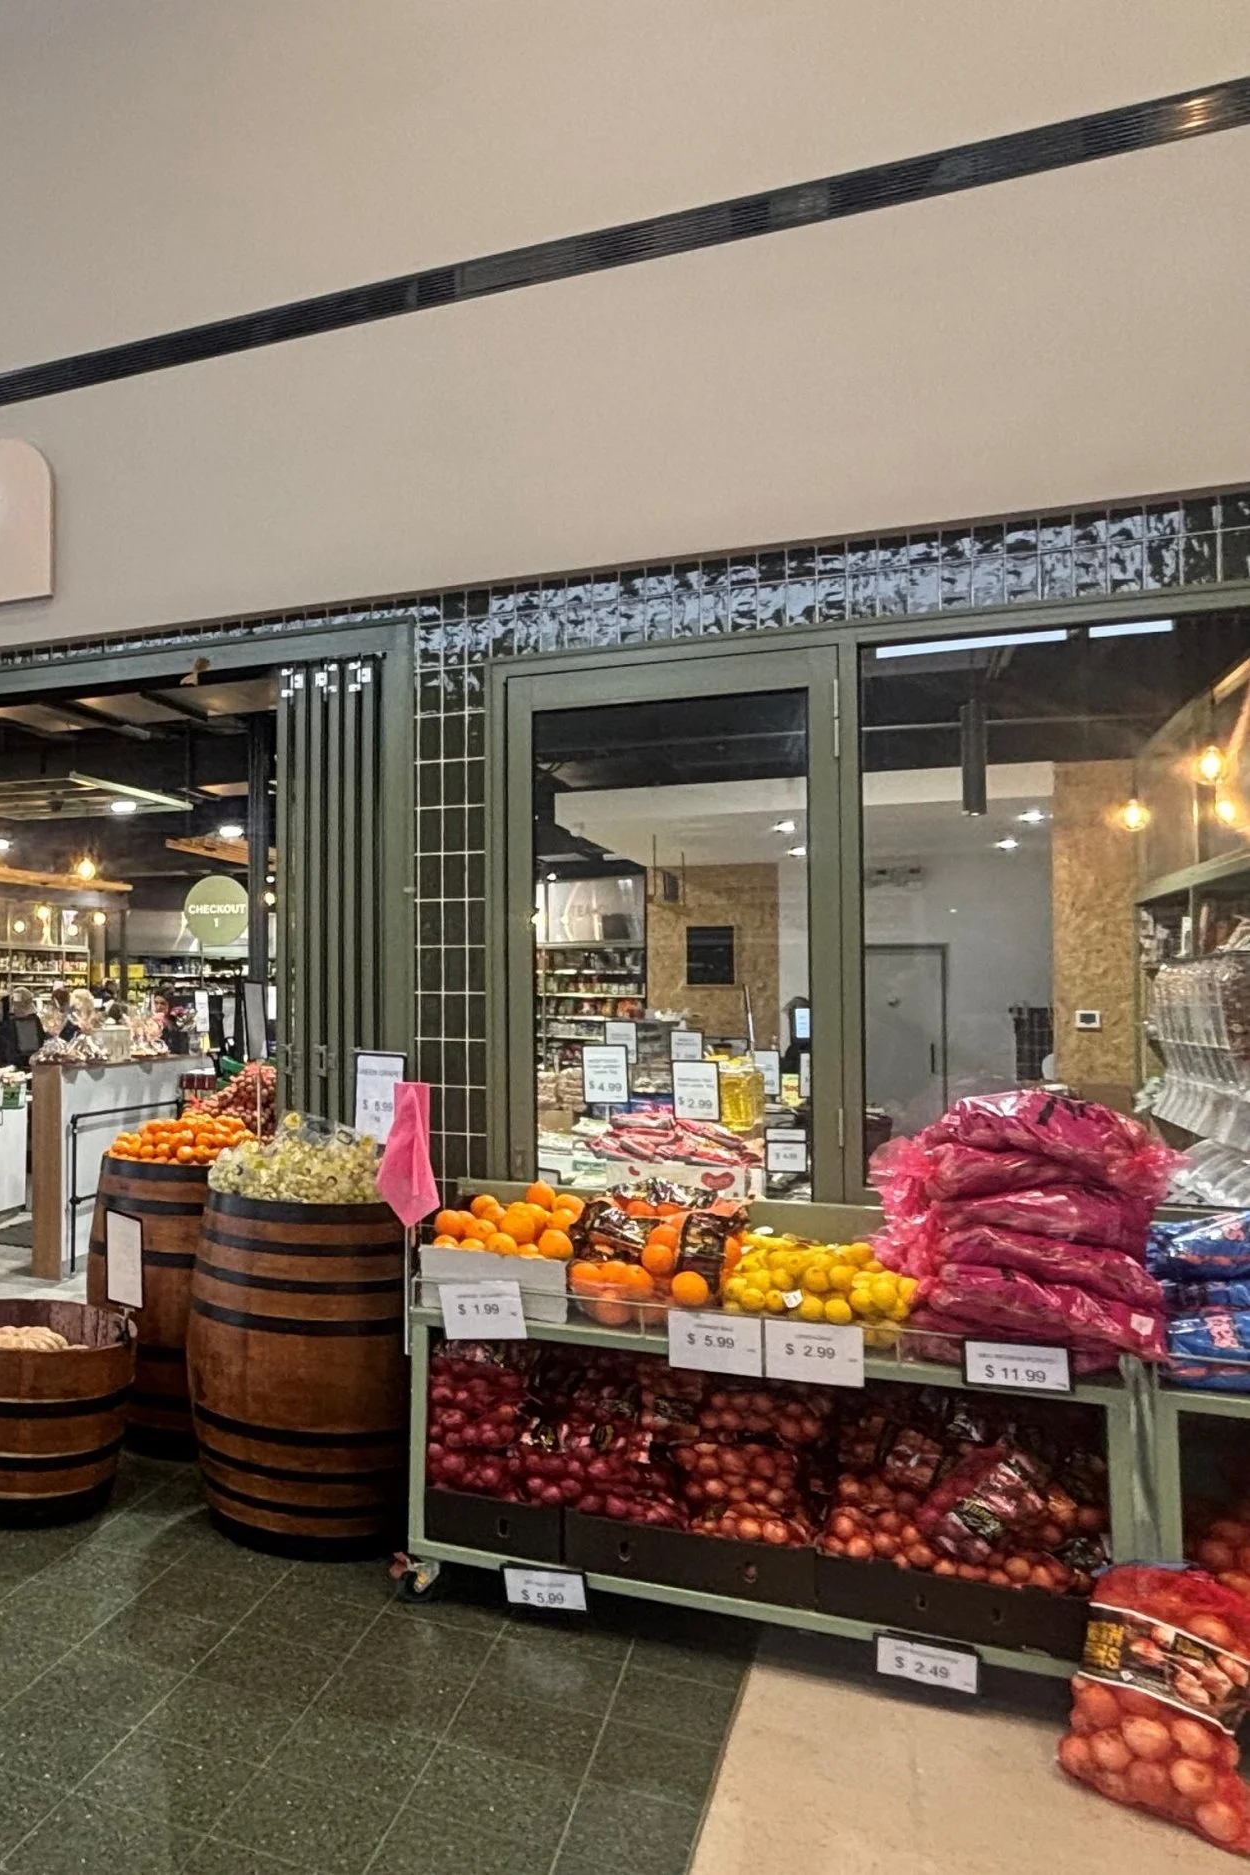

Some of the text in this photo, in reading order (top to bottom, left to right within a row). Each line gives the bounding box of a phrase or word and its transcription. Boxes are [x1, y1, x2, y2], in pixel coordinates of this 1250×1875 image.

[188, 903, 246, 914] CHECKOUT
[213, 917, 219, 928] 1
[589, 1080, 623, 1093] $ 4.99
[362, 1099, 368, 1110] $
[678, 1096, 713, 1110] $ 2.99
[457, 1303, 467, 1316] $
[474, 1303, 500, 1315] 1.99
[687, 1333, 735, 1349] $ 5.99
[785, 1343, 836, 1359] $ 2.99
[985, 1364, 1047, 1383] $ 11.99
[521, 1589, 564, 1604] $ 5.99
[894, 1656, 950, 1679] $ 2.49
